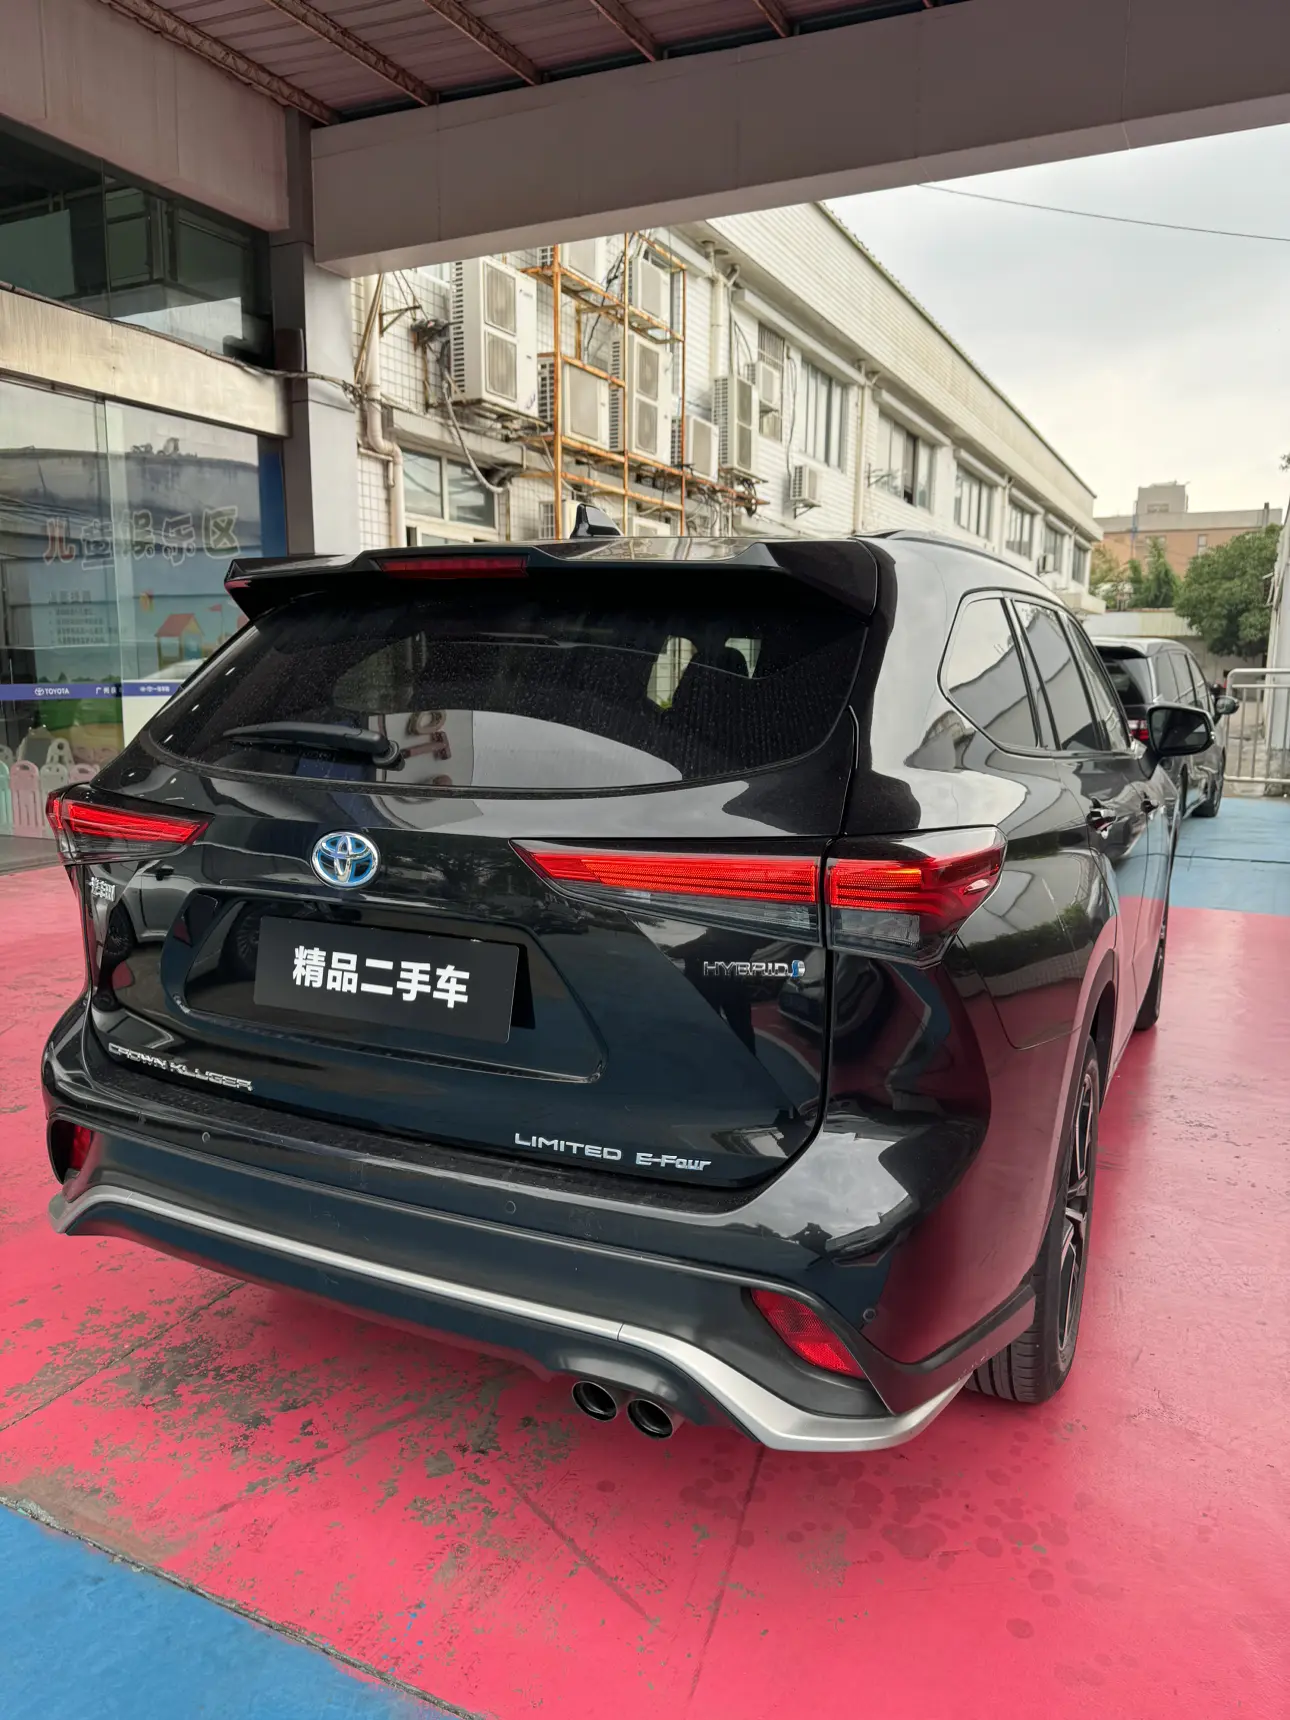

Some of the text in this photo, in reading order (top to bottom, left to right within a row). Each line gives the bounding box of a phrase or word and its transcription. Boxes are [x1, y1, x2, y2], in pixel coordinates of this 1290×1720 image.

[43, 505, 241, 570] 儿童娱乐区
[44, 688, 70, 696] TOYOTA
[292, 945, 470, 1008] 精品二手车
[703, 961, 790, 977] HYBRID
[108, 1042, 254, 1092] CROWN KLUGER
[514, 1132, 712, 1171] LIMITED E-Four
